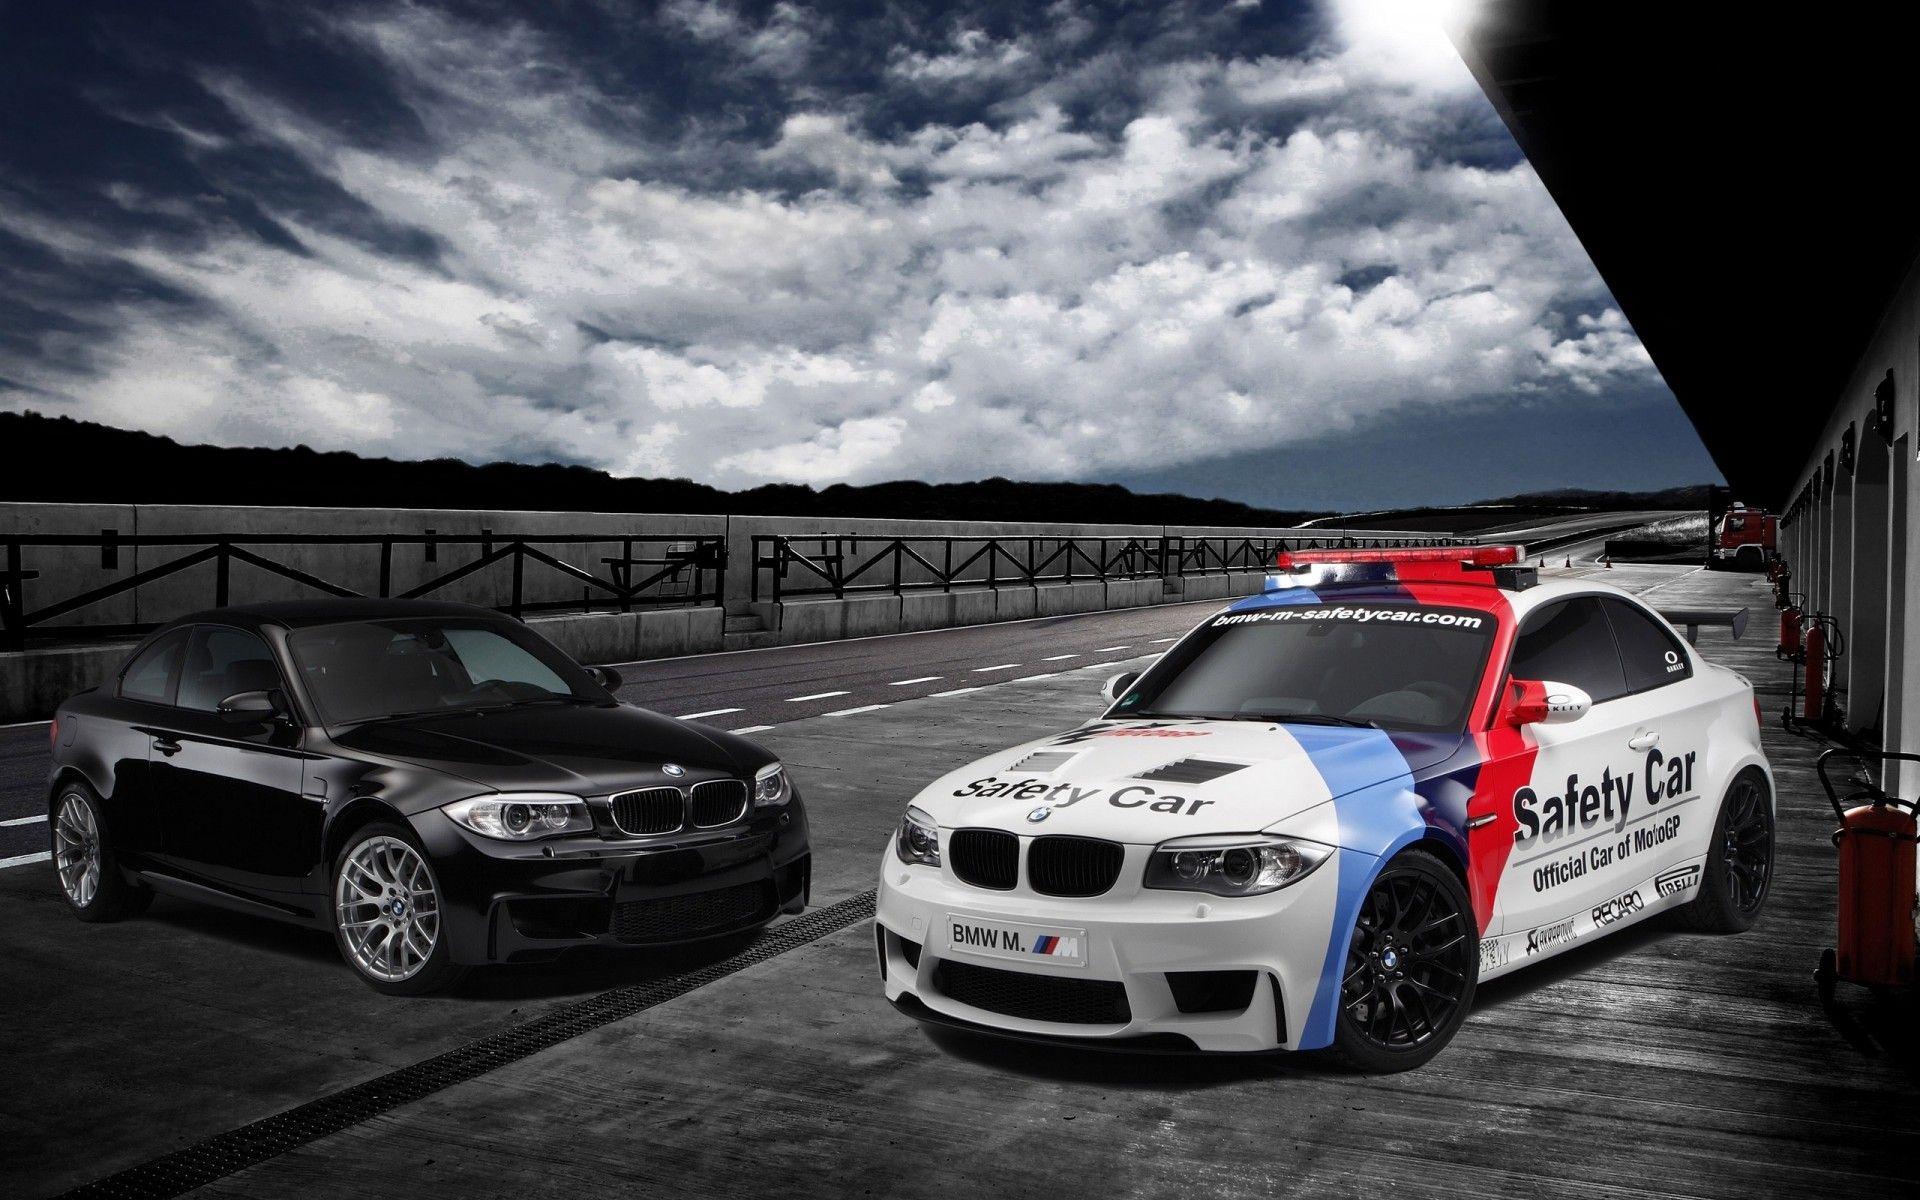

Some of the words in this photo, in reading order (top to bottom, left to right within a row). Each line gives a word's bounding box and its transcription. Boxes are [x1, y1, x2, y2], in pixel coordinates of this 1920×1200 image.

[1211, 606, 1482, 629] bmw-m-safetycar.com
[952, 776, 1103, 808] Safety
[1108, 785, 1216, 816] Car
[1513, 765, 1635, 851] Safety
[1645, 748, 1696, 806] Car
[1532, 851, 1588, 893] Official
[1590, 845, 1615, 871] Car
[1617, 833, 1632, 866] of
[1634, 814, 1682, 851] MotoGP
[1591, 890, 1645, 929] RECARO
[952, 923, 999, 949] BMW
